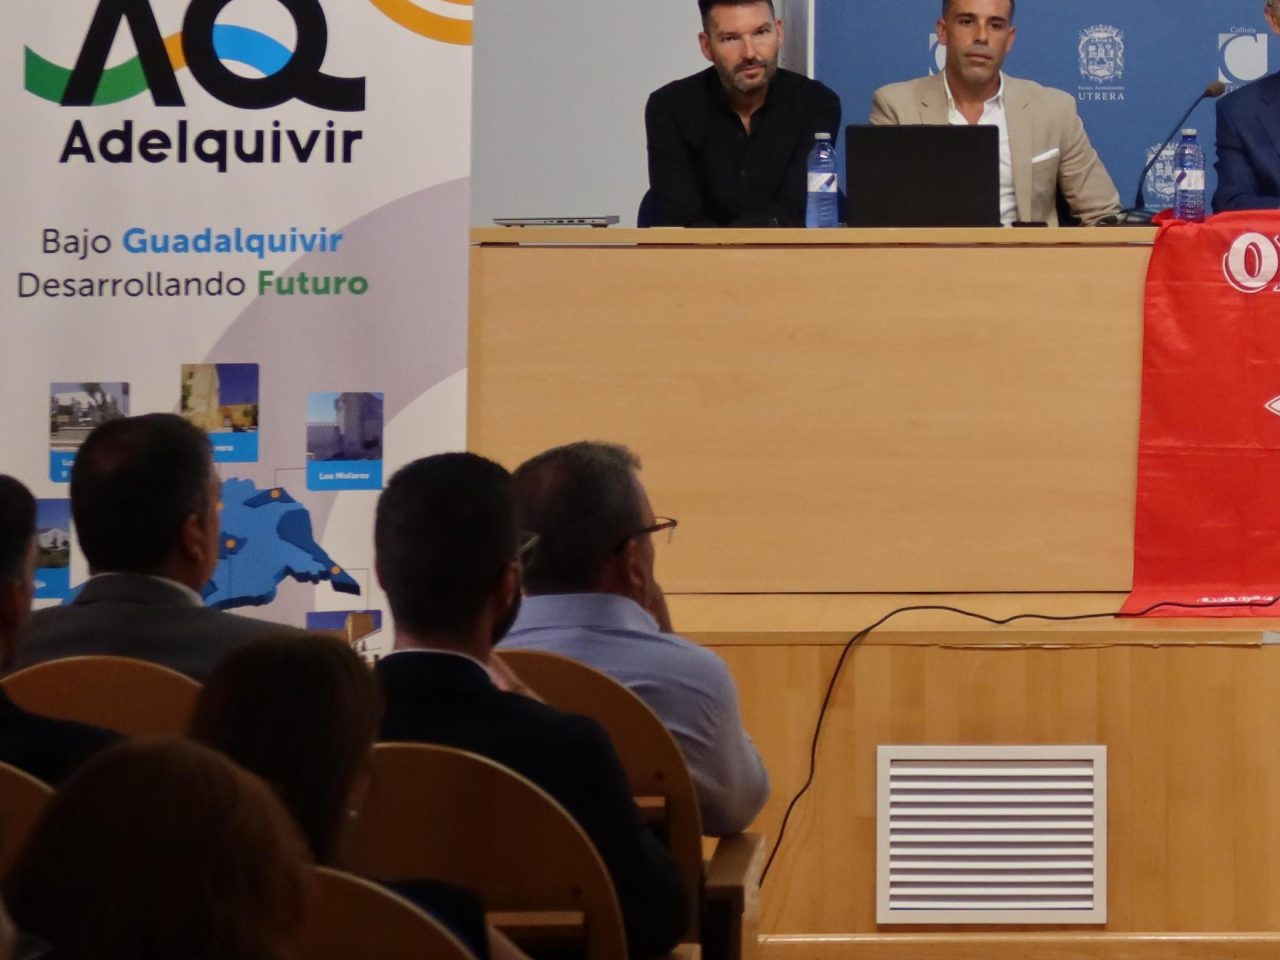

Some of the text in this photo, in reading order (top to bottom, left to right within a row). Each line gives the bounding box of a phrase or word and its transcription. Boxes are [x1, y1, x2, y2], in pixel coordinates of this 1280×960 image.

[1078, 92, 1125, 101] UTRERA
[58, 119, 364, 173] Adelquivir
[42, 227, 344, 260] Bajo Guadalquivir
[17, 269, 369, 298] Desarrollando Futuro
